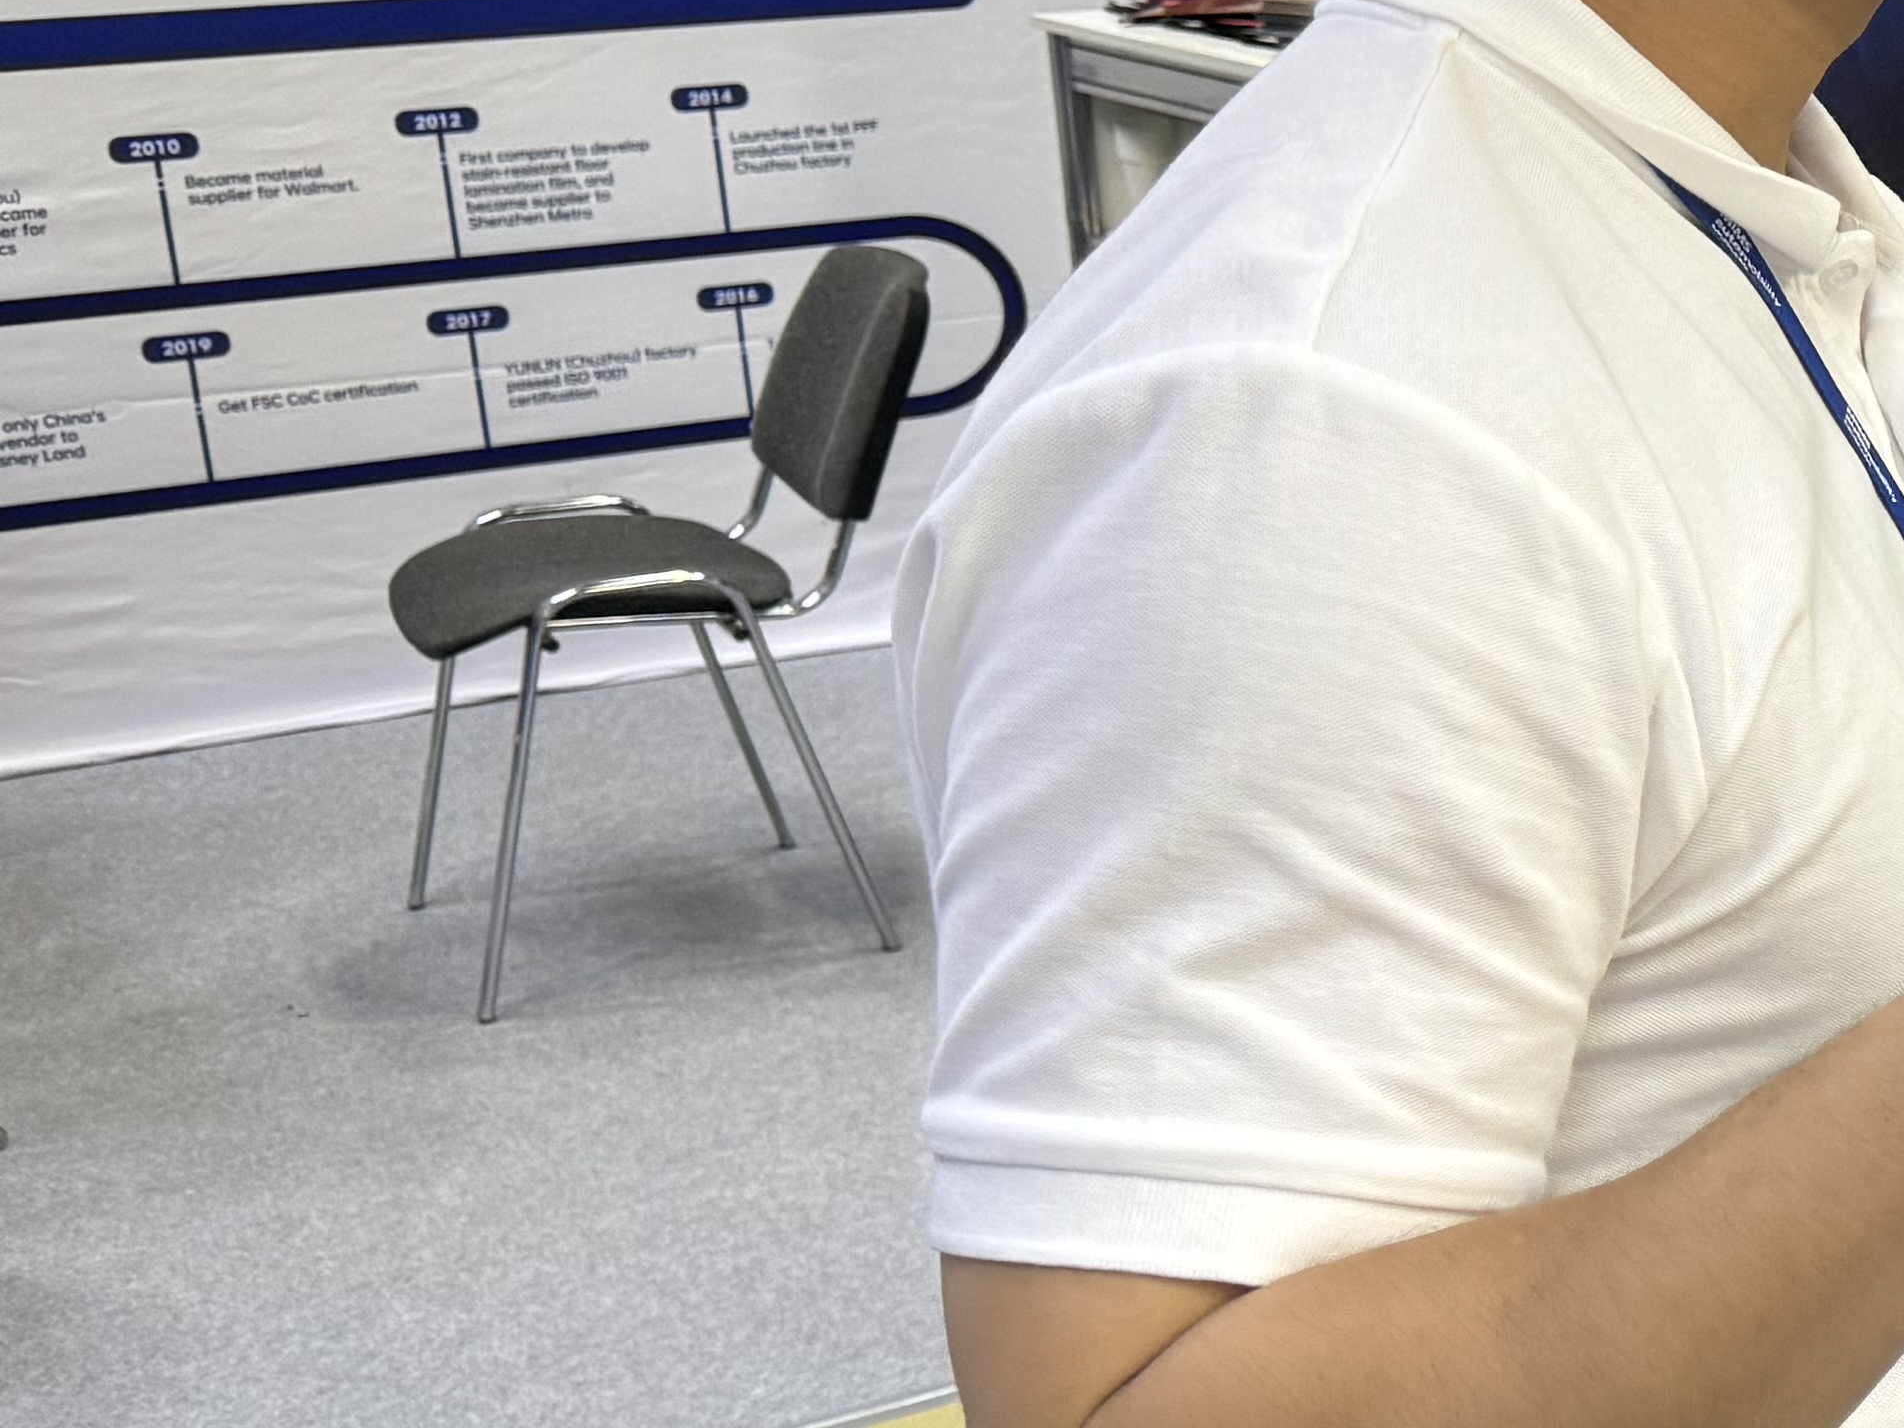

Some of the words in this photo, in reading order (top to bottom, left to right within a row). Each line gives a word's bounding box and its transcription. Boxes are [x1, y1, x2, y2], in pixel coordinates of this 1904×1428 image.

[688, 87, 733, 108] 2014
[414, 112, 462, 130] 2012
[130, 138, 181, 157] 2010
[459, 151, 493, 166] First
[496, 147, 567, 164] company
[591, 138, 650, 156] develop
[184, 174, 252, 190] Became
[255, 164, 324, 185] material
[188, 187, 253, 207] supplier
[257, 185, 281, 201] for
[22, 222, 46, 239] for
[714, 289, 758, 306] 2016
[445, 311, 491, 330] 2017
[161, 338, 213, 357] 2019
[218, 398, 248, 414] Get
[251, 394, 282, 411] FSC
[286, 390, 320, 407] CoC
[323, 380, 419, 404] certification
[2, 413, 40, 434] only
[43, 408, 107, 429] China's
[59, 429, 79, 444] to
[43, 445, 87, 462] Land
